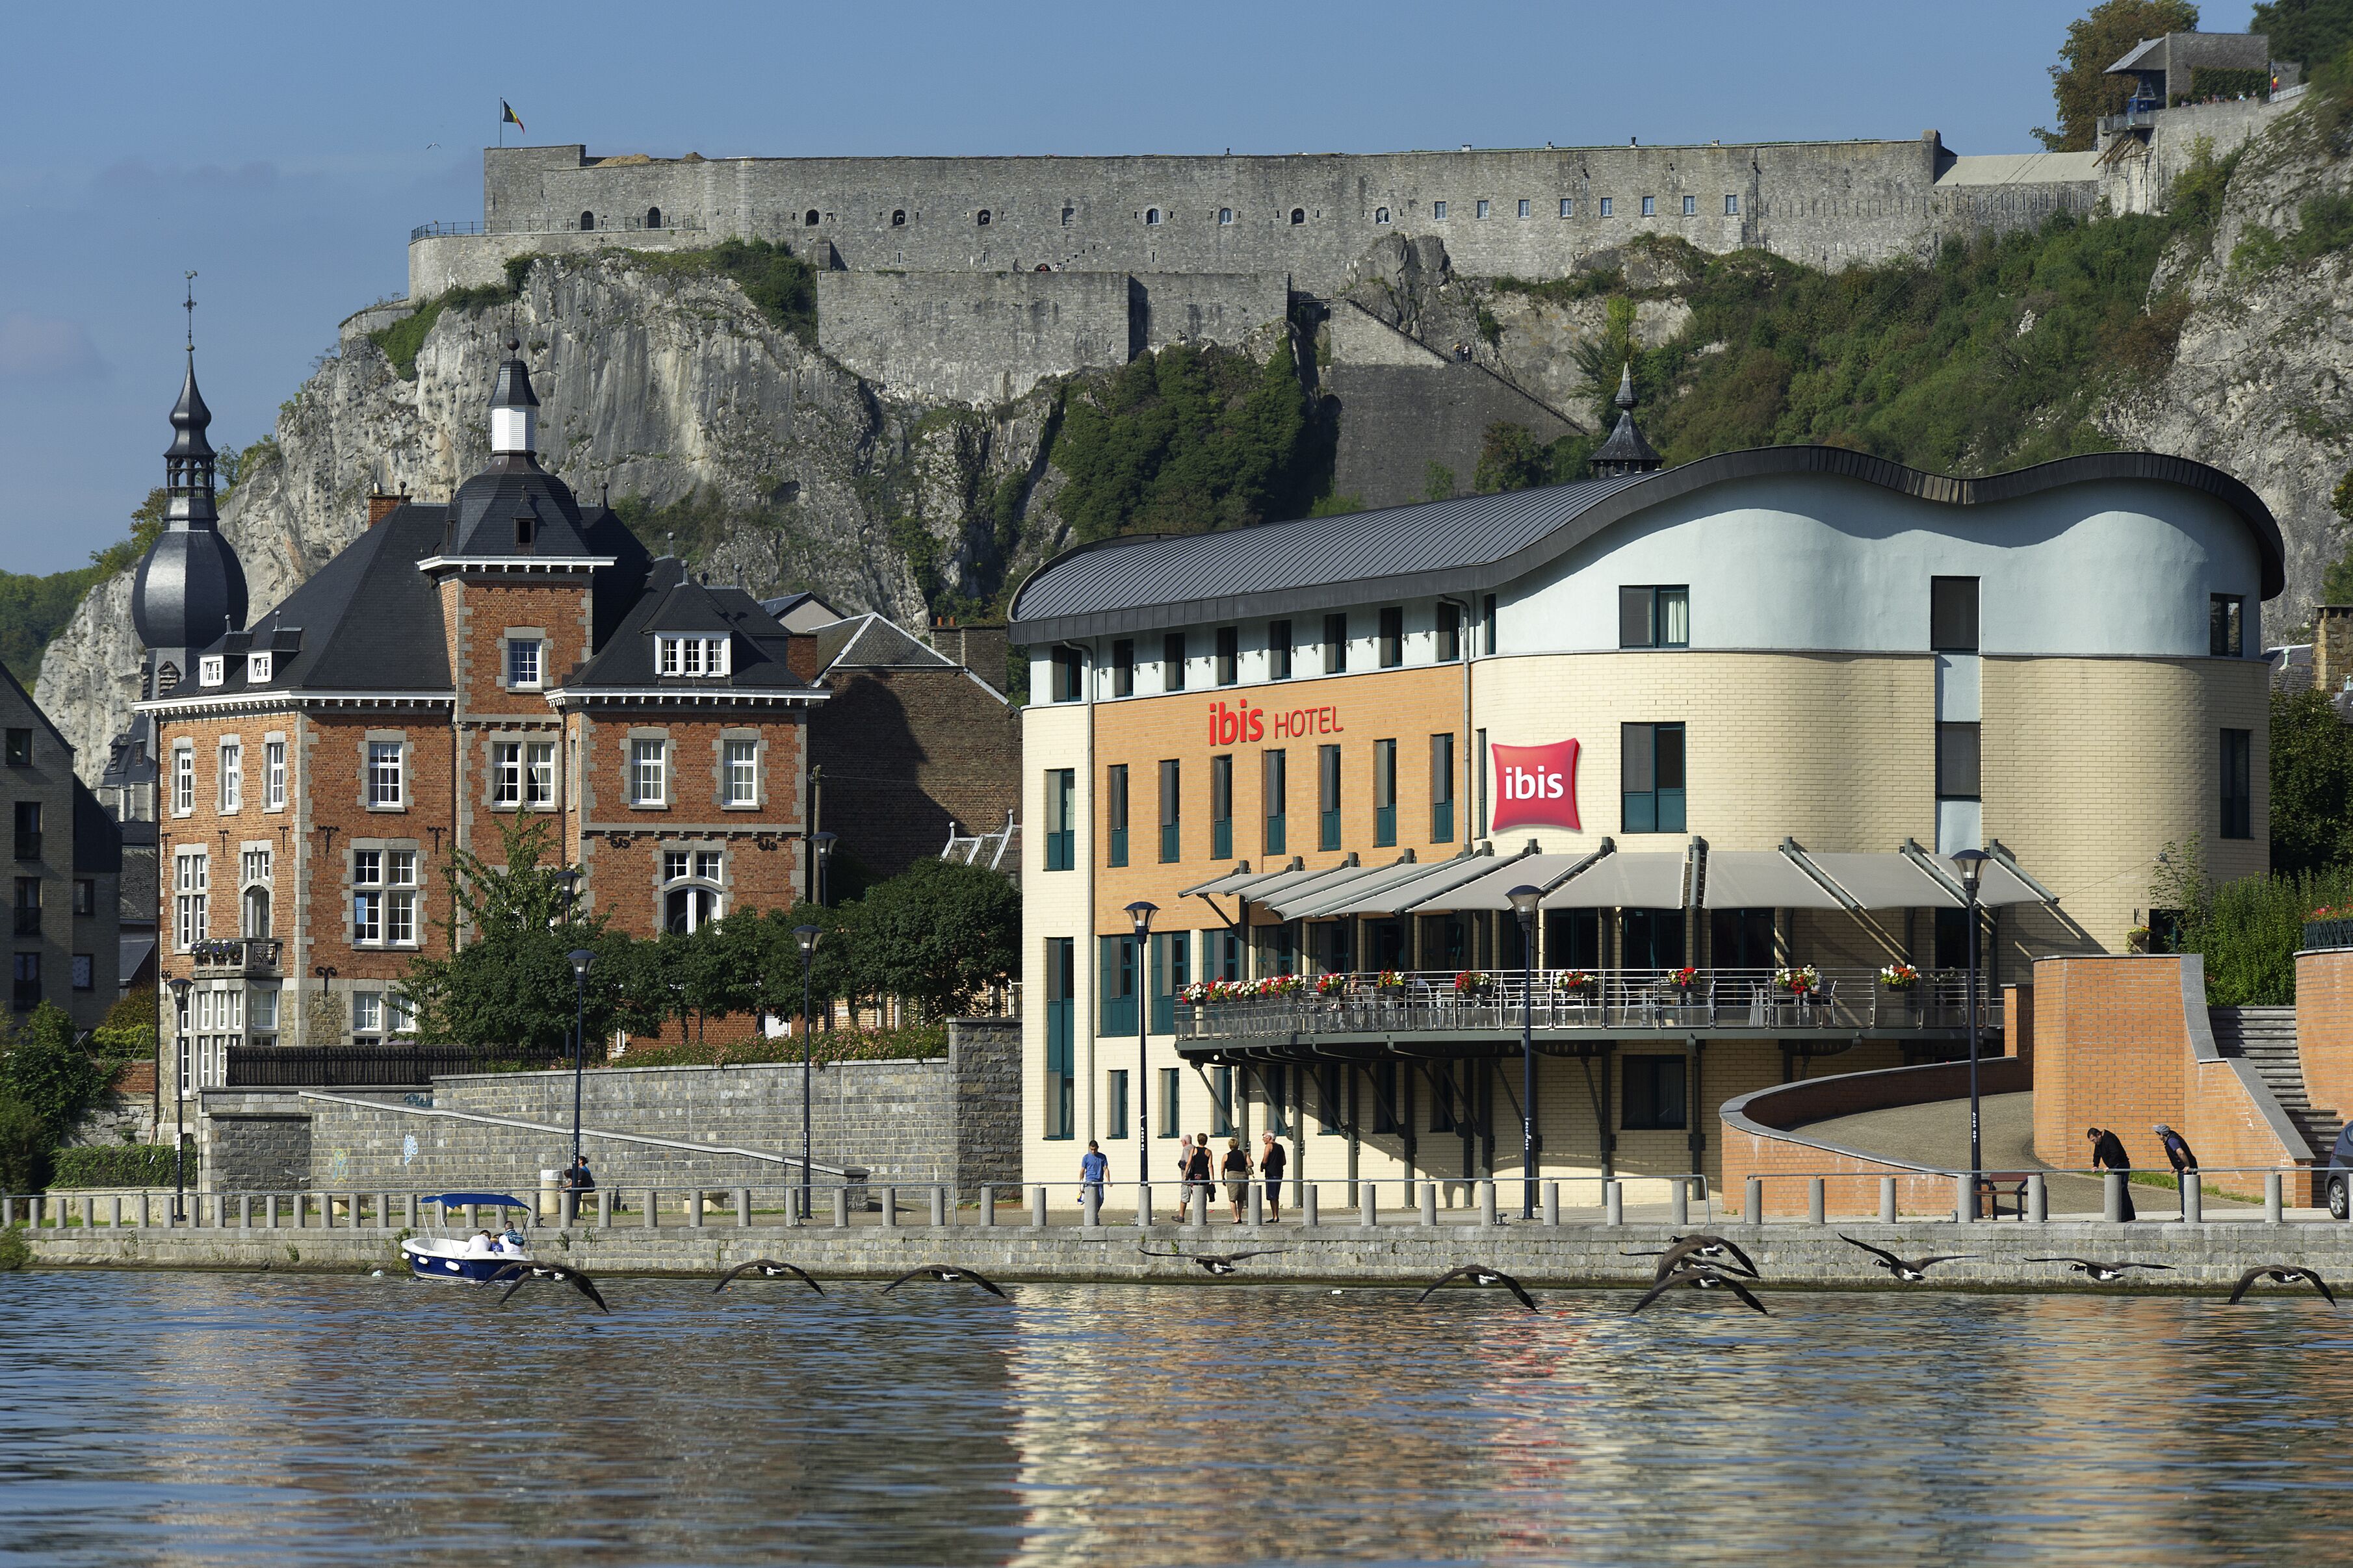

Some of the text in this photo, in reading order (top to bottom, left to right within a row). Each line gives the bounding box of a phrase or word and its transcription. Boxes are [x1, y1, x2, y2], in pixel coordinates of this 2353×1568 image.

[1210, 699, 1344, 746] ibis HOTEL
[1505, 765, 1564, 799] ibis
